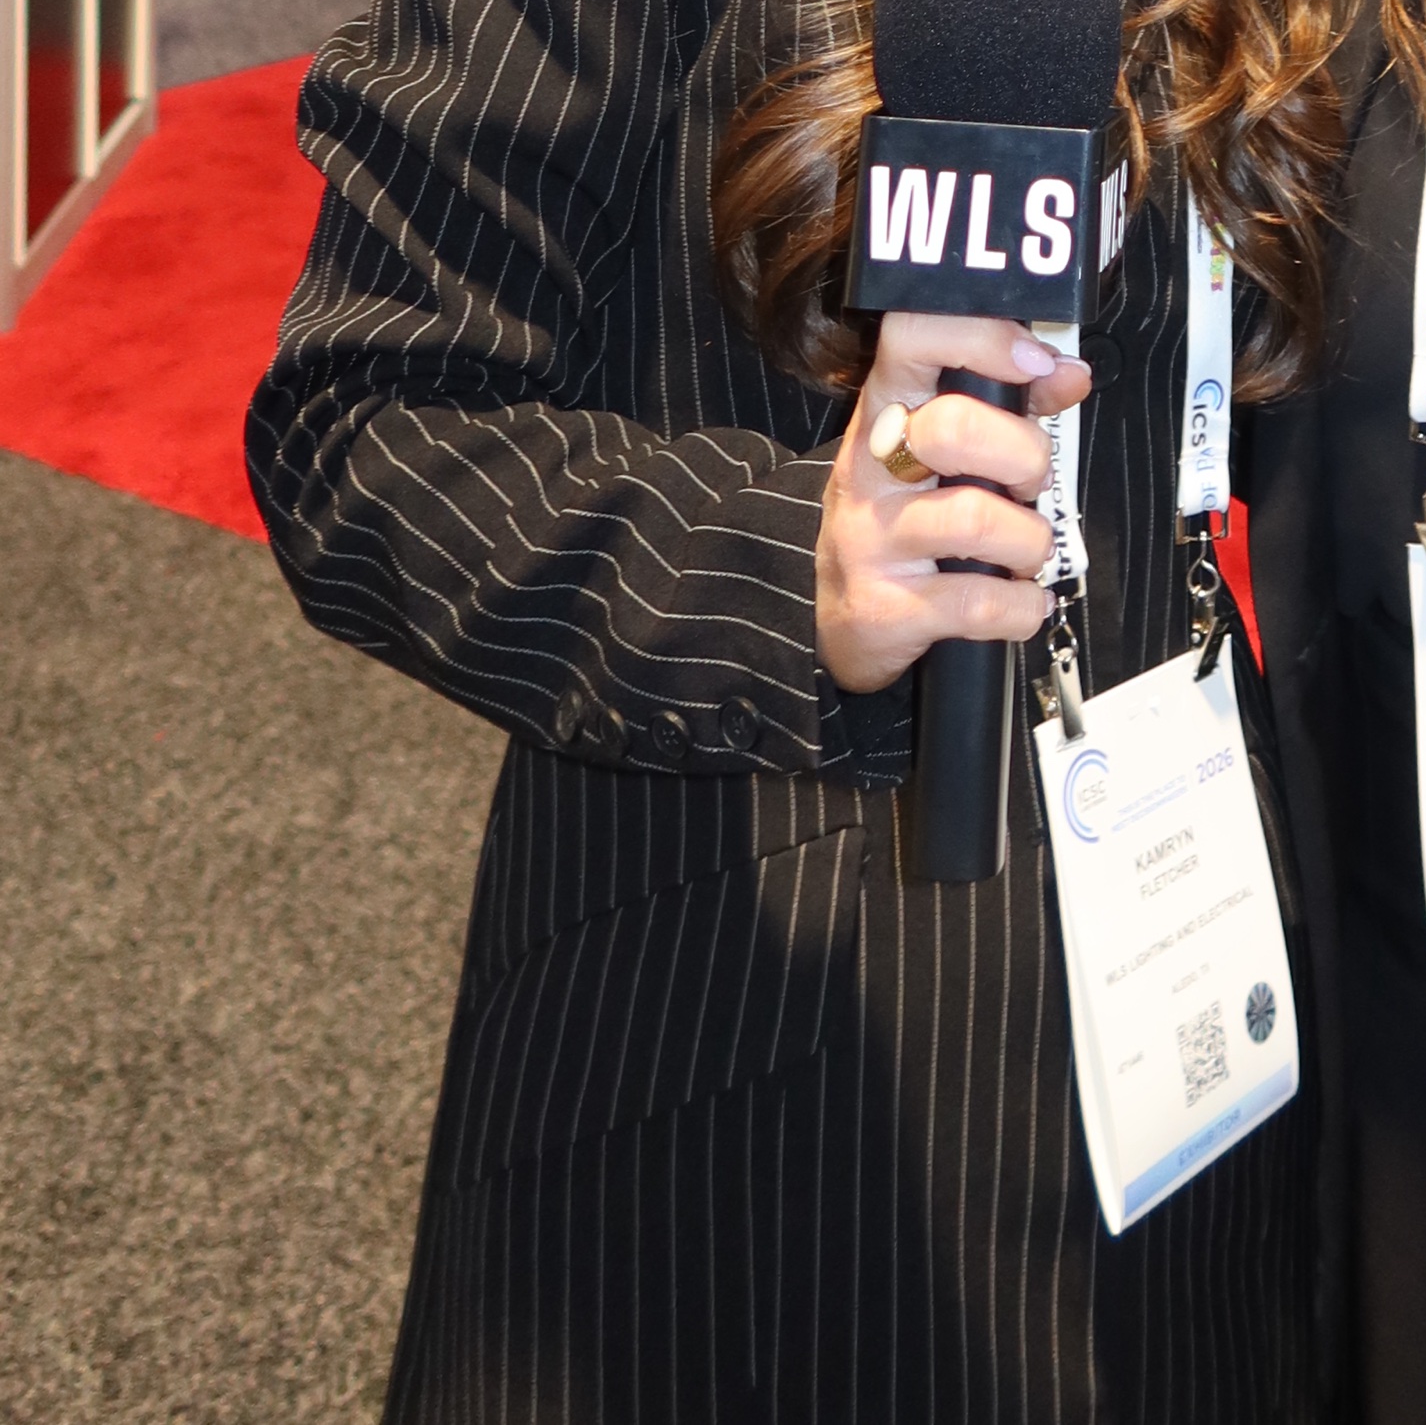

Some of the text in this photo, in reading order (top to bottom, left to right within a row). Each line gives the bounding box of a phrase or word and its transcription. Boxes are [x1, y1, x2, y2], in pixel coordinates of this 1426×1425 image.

[869, 165, 1076, 276] WLS
[1191, 403, 1208, 448] ICS
[1196, 747, 1234, 784] 2026
[1135, 825, 1195, 873] KAMRYN
[1140, 854, 1200, 899] FLETCHER
